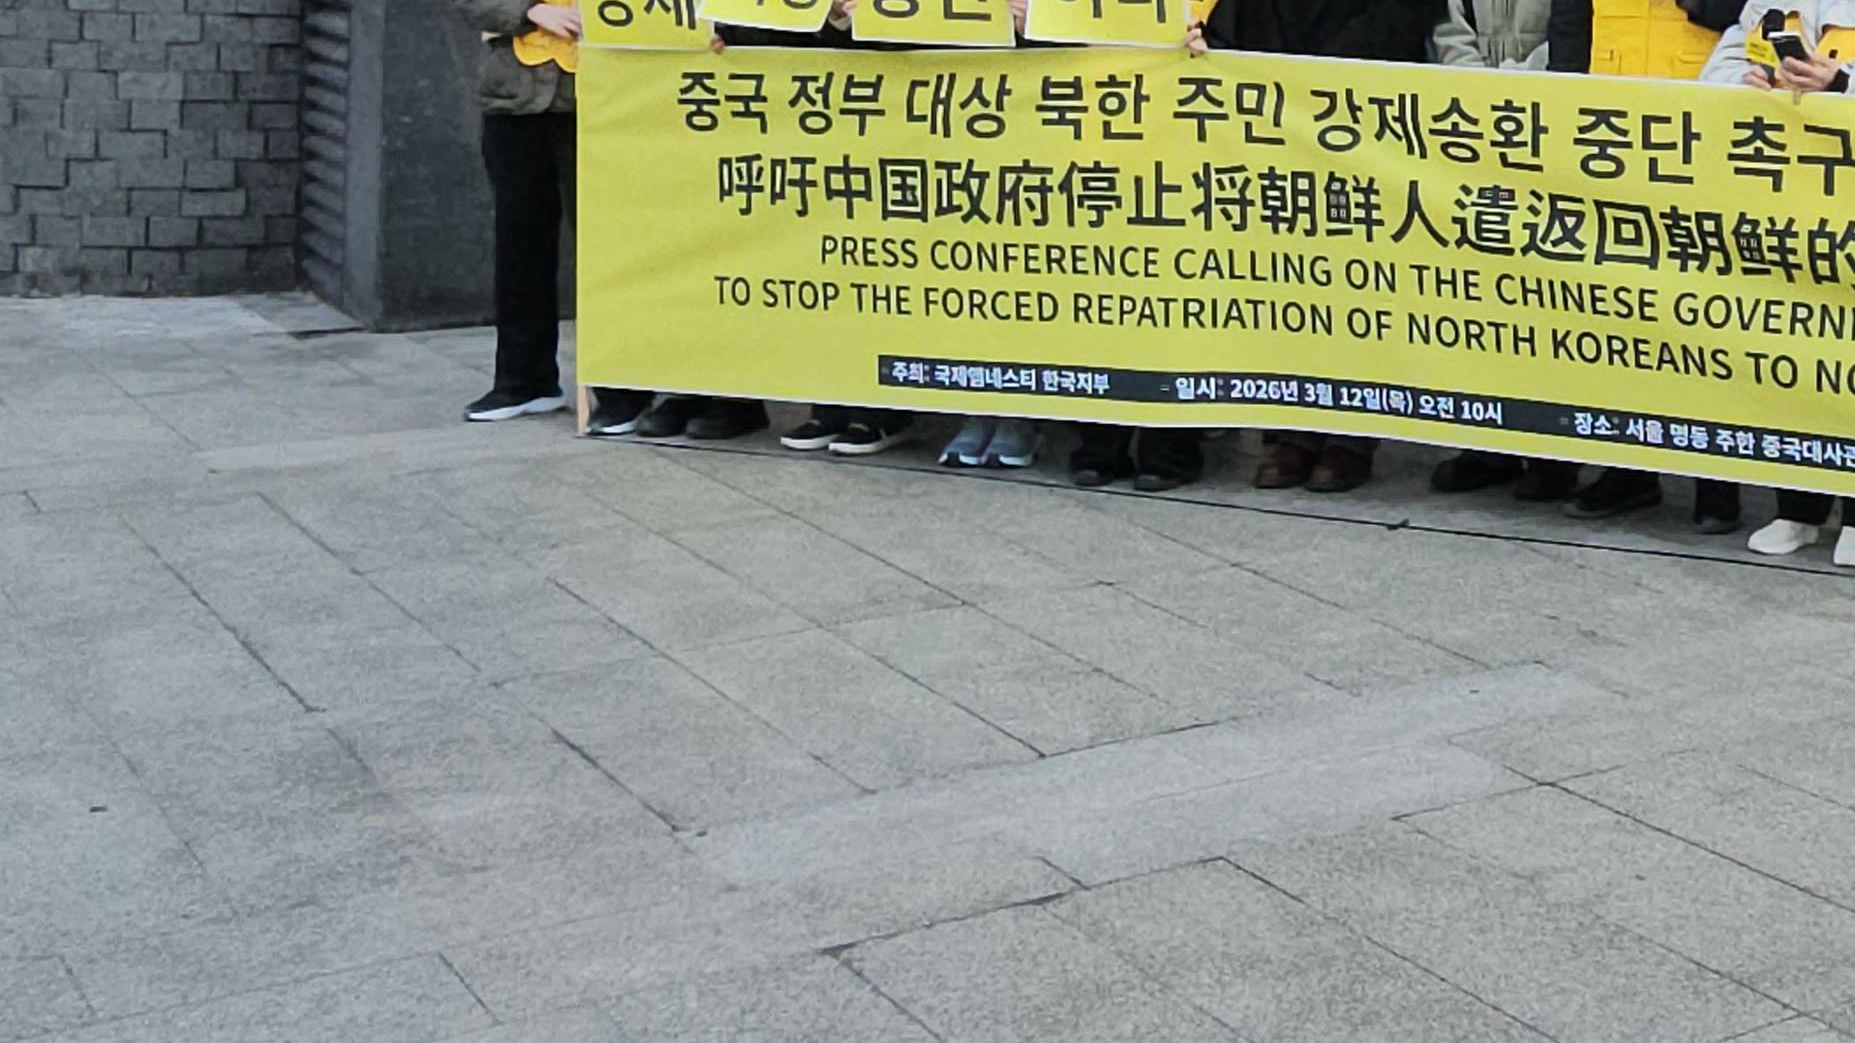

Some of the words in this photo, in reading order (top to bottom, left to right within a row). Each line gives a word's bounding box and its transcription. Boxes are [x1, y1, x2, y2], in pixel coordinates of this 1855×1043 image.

[677, 71, 770, 134] 중국
[788, 72, 887, 137] 정부
[906, 73, 1013, 140] 대상
[1034, 74, 1151, 142] 북한
[1173, 75, 1287, 146] 주민
[1310, 87, 1549, 173] 강제송환
[1572, 106, 1703, 185] 중단
[820, 234, 920, 270] PRESS
[930, 238, 1162, 280] CONFERENCE
[1173, 247, 1333, 288] CALLING
[1345, 258, 1397, 294] ON
[1409, 263, 1483, 303] THE
[1495, 272, 1659, 324] CHINESE
[714, 275, 752, 307] TO
[762, 278, 841, 314] STOP
[850, 282, 913, 316] THE
[923, 287, 1060, 323] FORCED
[1072, 292, 1334, 336] REPATRIATION
[1346, 306, 1393, 342] OF
[1407, 310, 1538, 358] NORTH
[1550, 326, 1734, 381] KOREANS
[1744, 350, 1799, 389] TO
[891, 360, 931, 385] 주최:
[1042, 369, 1111, 395] 한국지부
[1175, 376, 1224, 401] 일시:
[1230, 378, 1299, 403] 2026년
[1304, 383, 1334, 407] 3월
[1340, 386, 1414, 415] 12일(목)
[1418, 394, 1455, 420] 오전
[1460, 400, 1503, 426] 10시
[1573, 412, 1621, 437] 장소:
[1625, 418, 1664, 446] 서울
[1669, 423, 1710, 451] 명동
[1715, 429, 1756, 457] 주한
